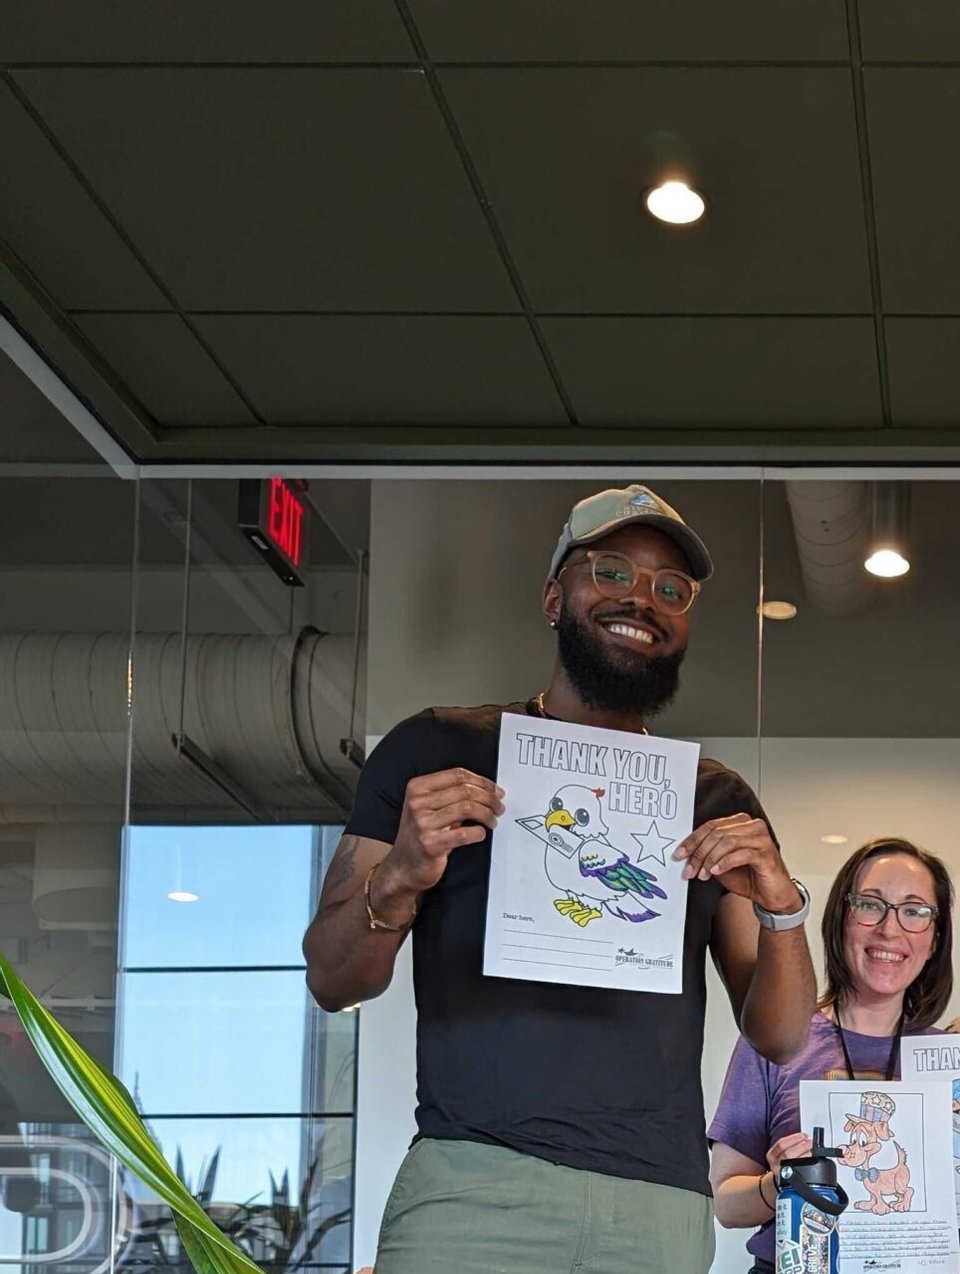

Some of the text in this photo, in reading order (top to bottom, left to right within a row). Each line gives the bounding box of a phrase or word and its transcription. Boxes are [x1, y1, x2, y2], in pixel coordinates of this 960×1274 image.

[268, 475, 305, 566] EXIT
[516, 733, 671, 790] THANK YOU,
[608, 781, 678, 820] HERO
[502, 912, 518, 920] Dear
[615, 955, 674, 969] OPERATION GRATITUDE
